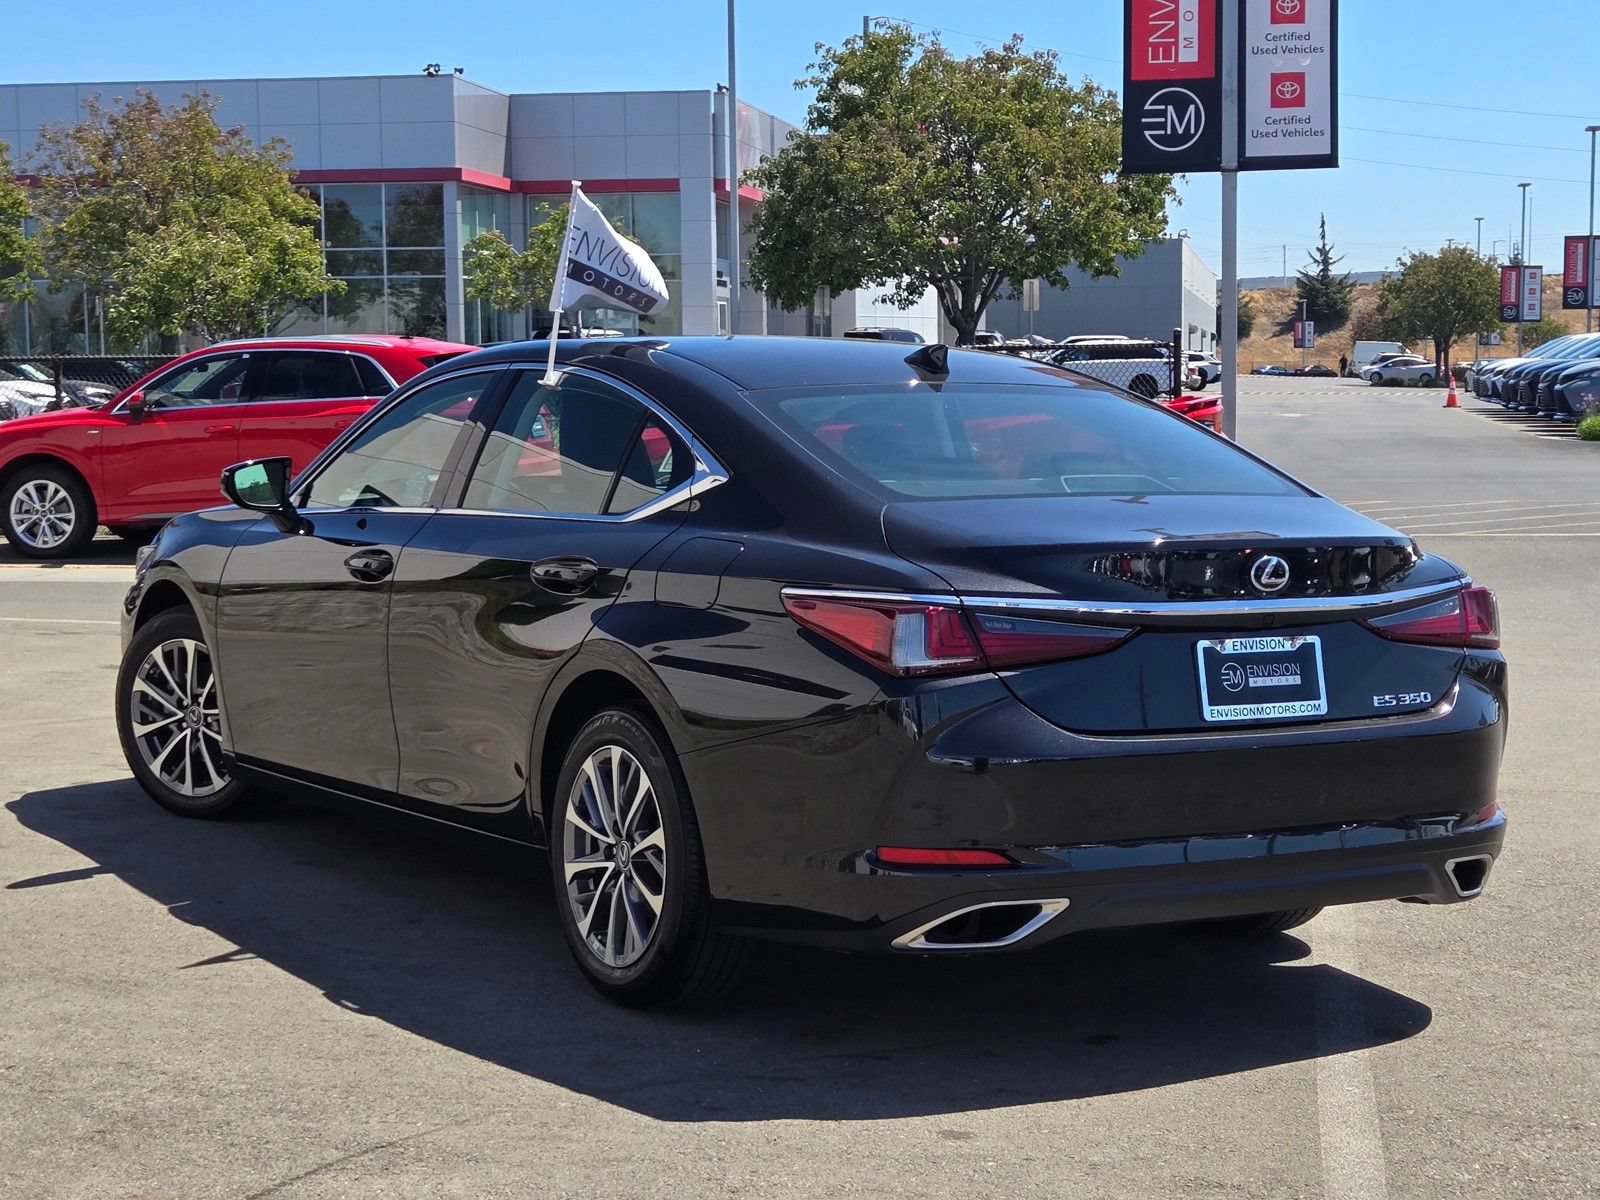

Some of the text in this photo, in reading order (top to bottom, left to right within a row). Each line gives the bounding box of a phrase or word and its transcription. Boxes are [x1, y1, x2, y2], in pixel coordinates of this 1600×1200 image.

[1265, 31, 1311, 42] Certified
[1251, 44, 1325, 55] Used Vehicles
[1264, 114, 1311, 125] Certified
[1251, 127, 1325, 139] Used Vehicles
[569, 226, 662, 297] NVISIO
[1232, 638, 1285, 651] ENVISION
[1246, 662, 1301, 677] ENVISION
[1253, 677, 1297, 686] MOTORS
[1373, 691, 1432, 707] ES 350
[1210, 703, 1322, 719] ENVISIONMOTORS.COM
